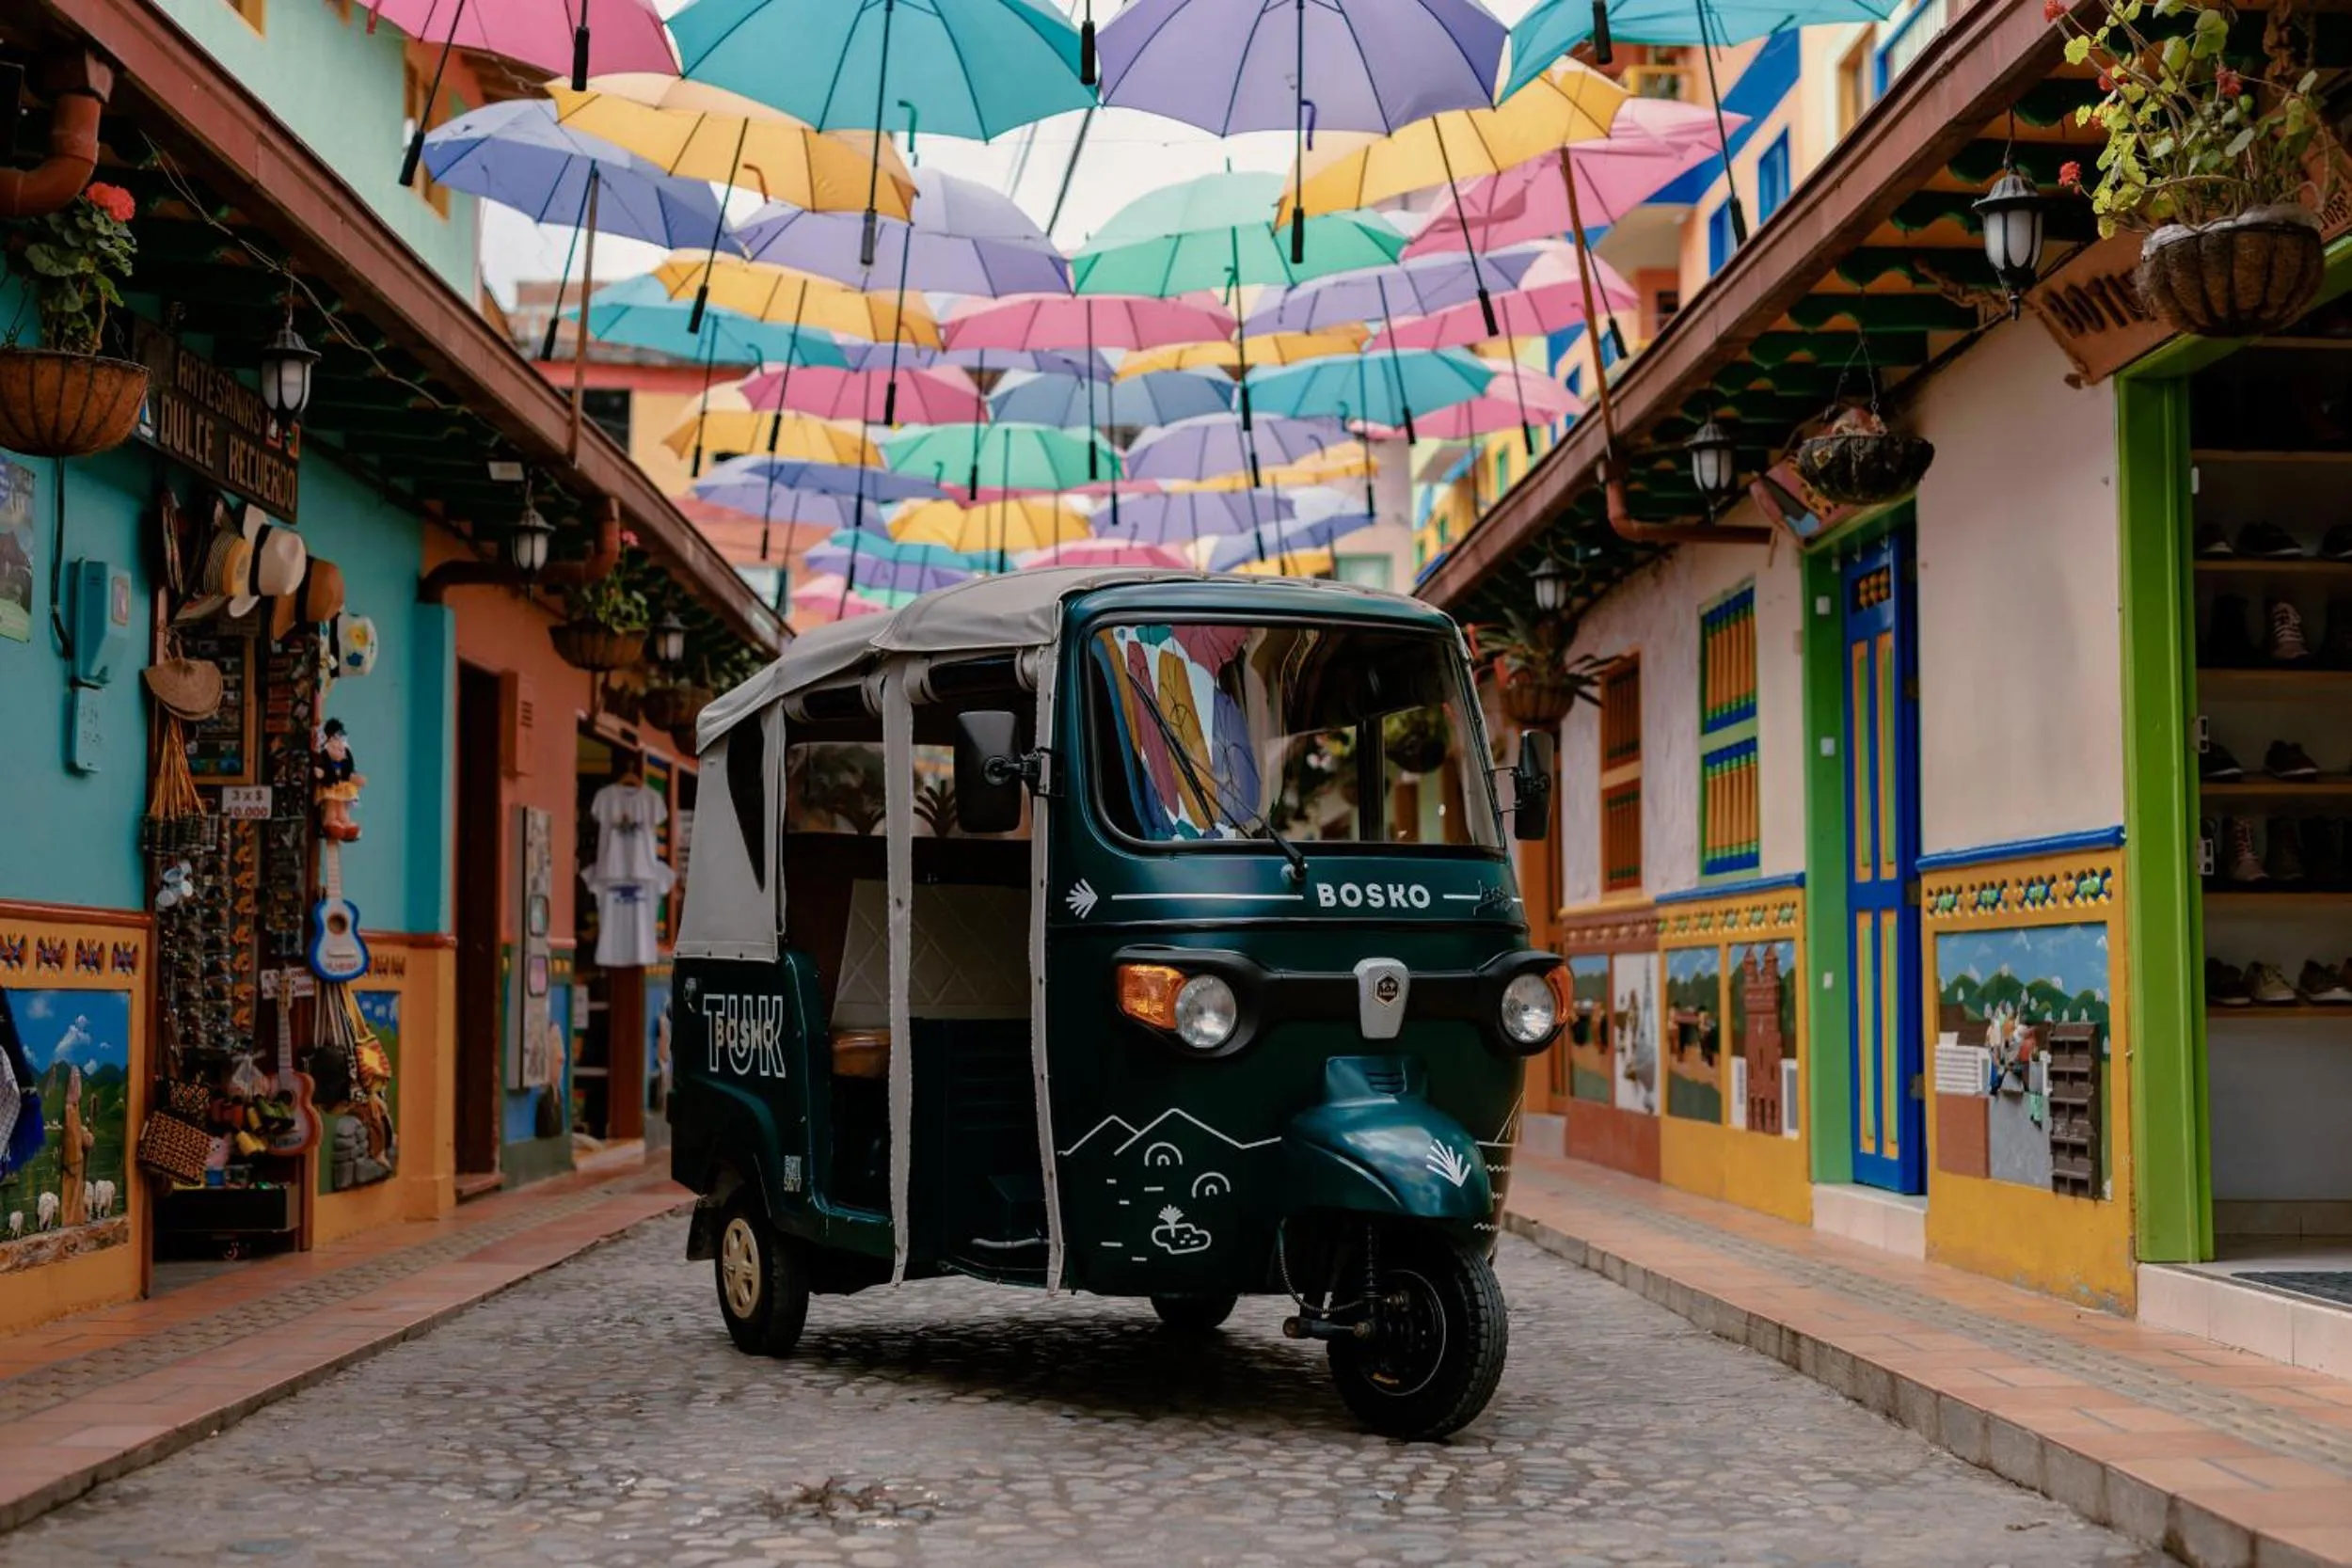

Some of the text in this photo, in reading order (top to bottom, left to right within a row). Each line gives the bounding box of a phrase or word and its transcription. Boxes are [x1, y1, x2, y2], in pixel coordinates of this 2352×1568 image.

[177, 350, 262, 434] ARTESANIAS
[160, 394, 295, 514] DULCE RECUERDO
[1316, 882, 1431, 909] BOSKO
[703, 993, 786, 1078] TUK
